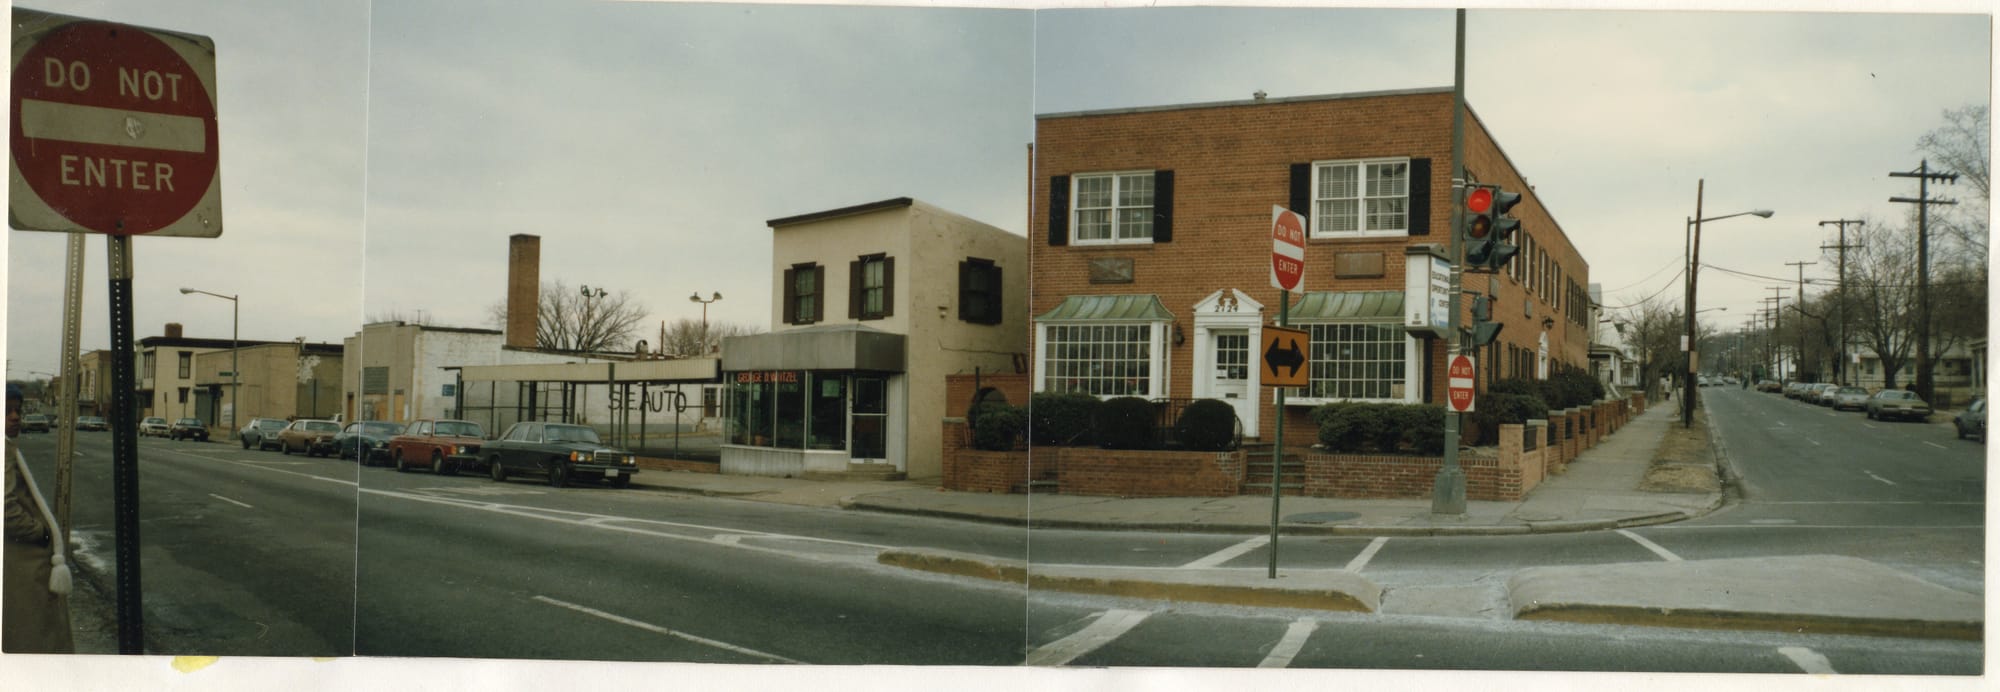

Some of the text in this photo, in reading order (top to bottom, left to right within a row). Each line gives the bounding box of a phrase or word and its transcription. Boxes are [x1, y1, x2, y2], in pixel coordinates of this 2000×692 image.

[44, 57, 183, 102] DO NOT
[60, 155, 175, 192] ENTER
[1277, 224, 1302, 242] DO NOT
[1278, 259, 1298, 275] ENTER
[1452, 365, 1471, 376] DO NOT
[638, 390, 687, 413] AUTO
[1453, 391, 1469, 400] ENTER
